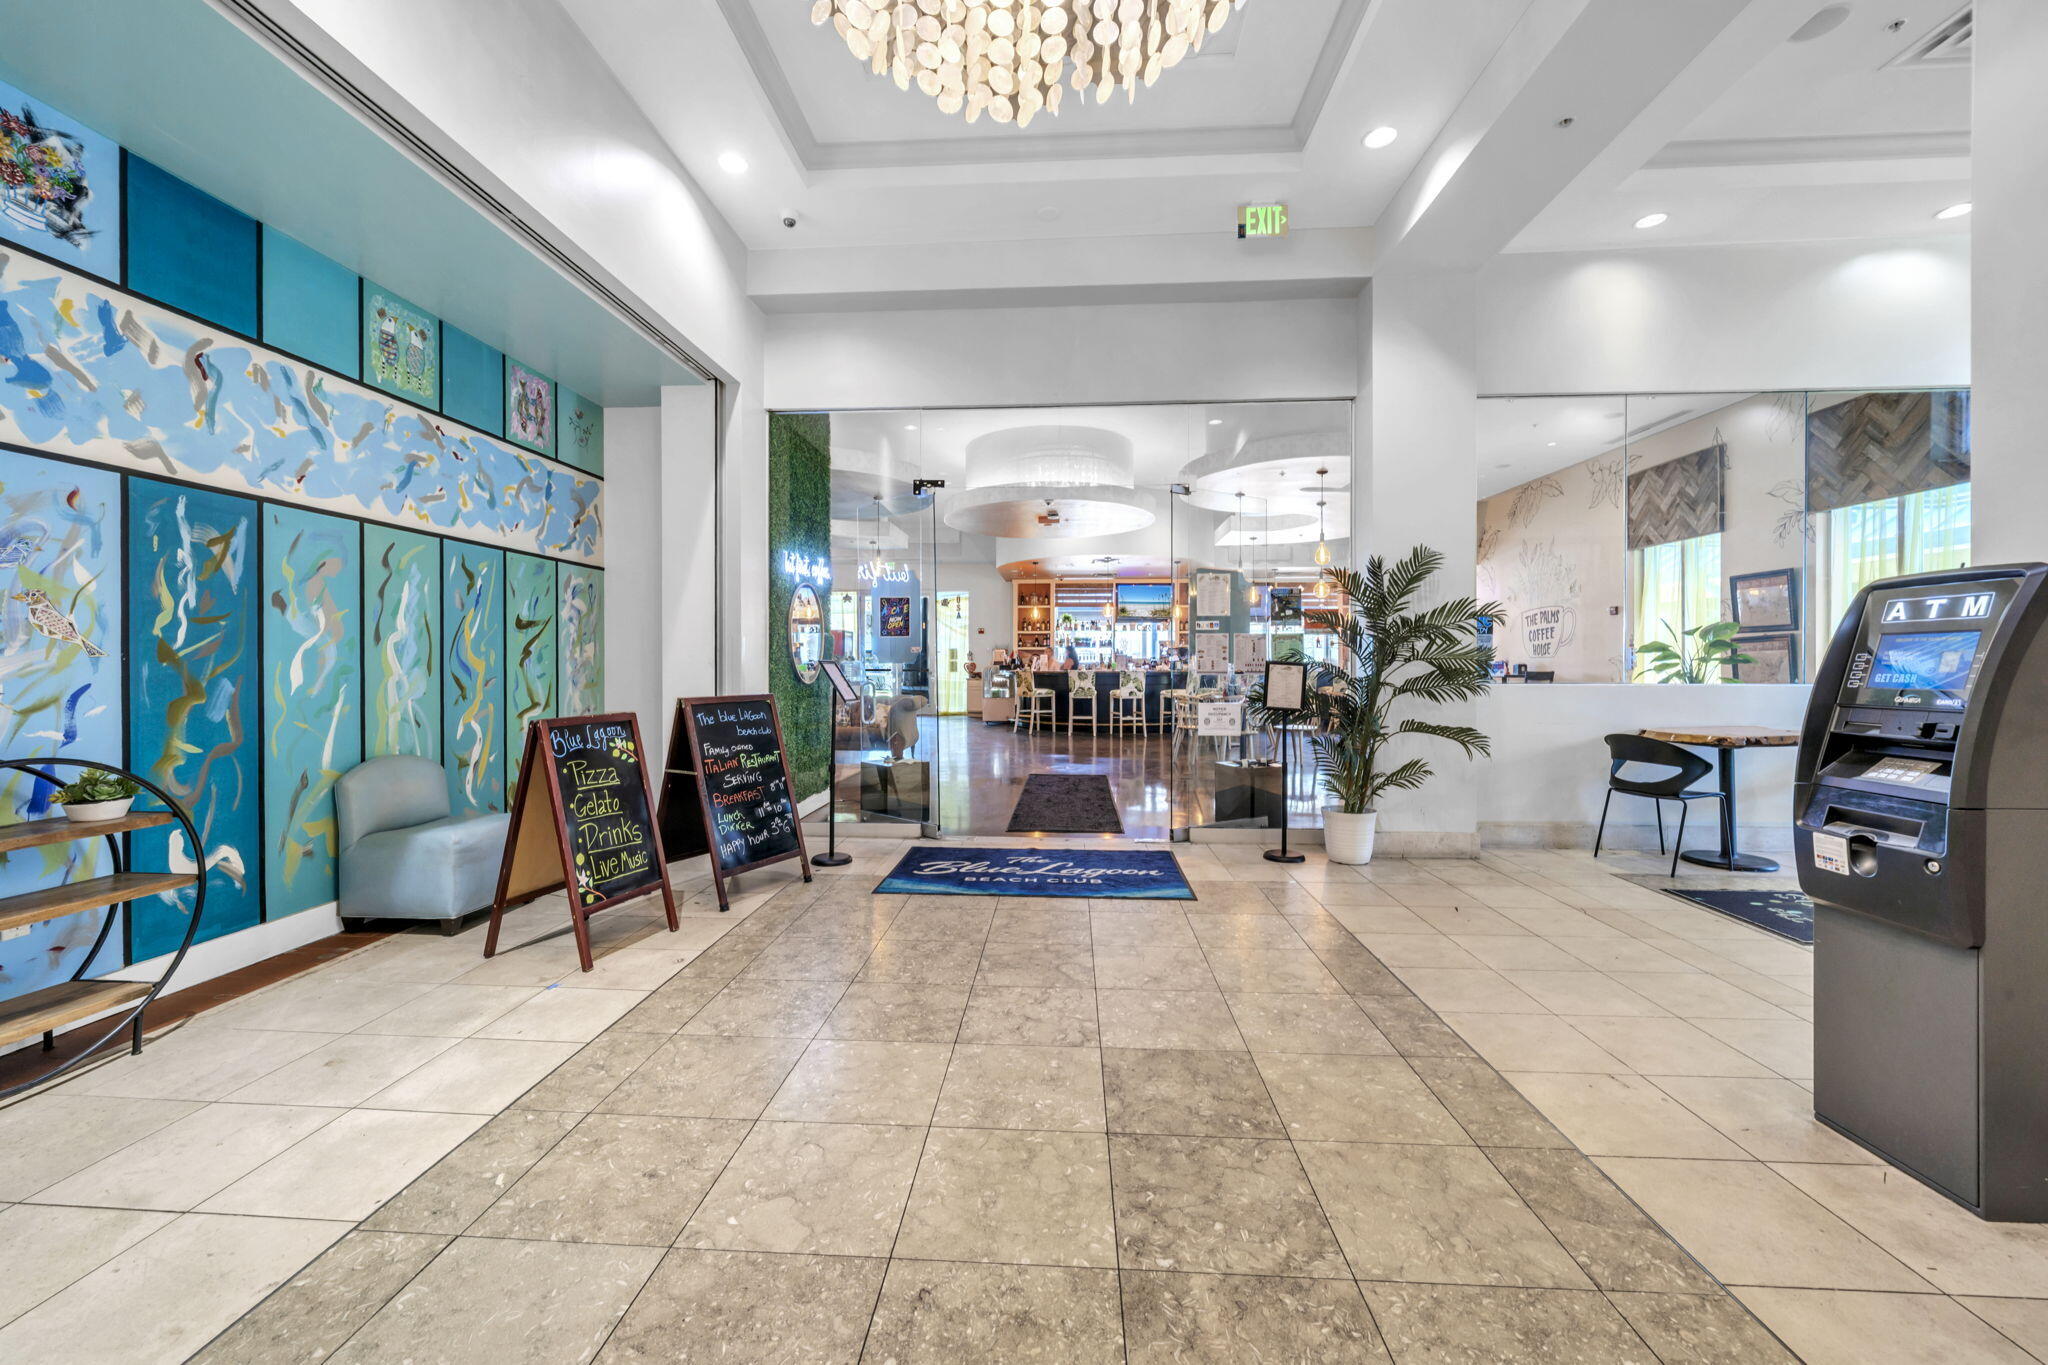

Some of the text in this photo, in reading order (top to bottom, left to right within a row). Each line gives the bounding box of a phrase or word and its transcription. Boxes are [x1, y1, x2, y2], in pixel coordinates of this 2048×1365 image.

[1245, 206, 1283, 235] EXIT
[887, 621, 904, 630] OPEN
[1524, 609, 1560, 627] THE PALMS
[1528, 626, 1555, 642] COFFEE
[1532, 642, 1552, 656] HOUSE
[1875, 673, 1918, 683] GET CASH
[696, 712, 715, 727] The
[549, 725, 627, 758] Blue Lagoon
[566, 760, 621, 786] Pizza
[574, 789, 620, 818] Gelato
[712, 785, 765, 808] BREAKFAST
[578, 817, 643, 850] Drinks
[720, 838, 746, 859] HAPPY
[590, 851, 648, 879] Live Music
[912, 860, 1164, 877] Blue Lagoon
[1006, 856, 1051, 864] The
